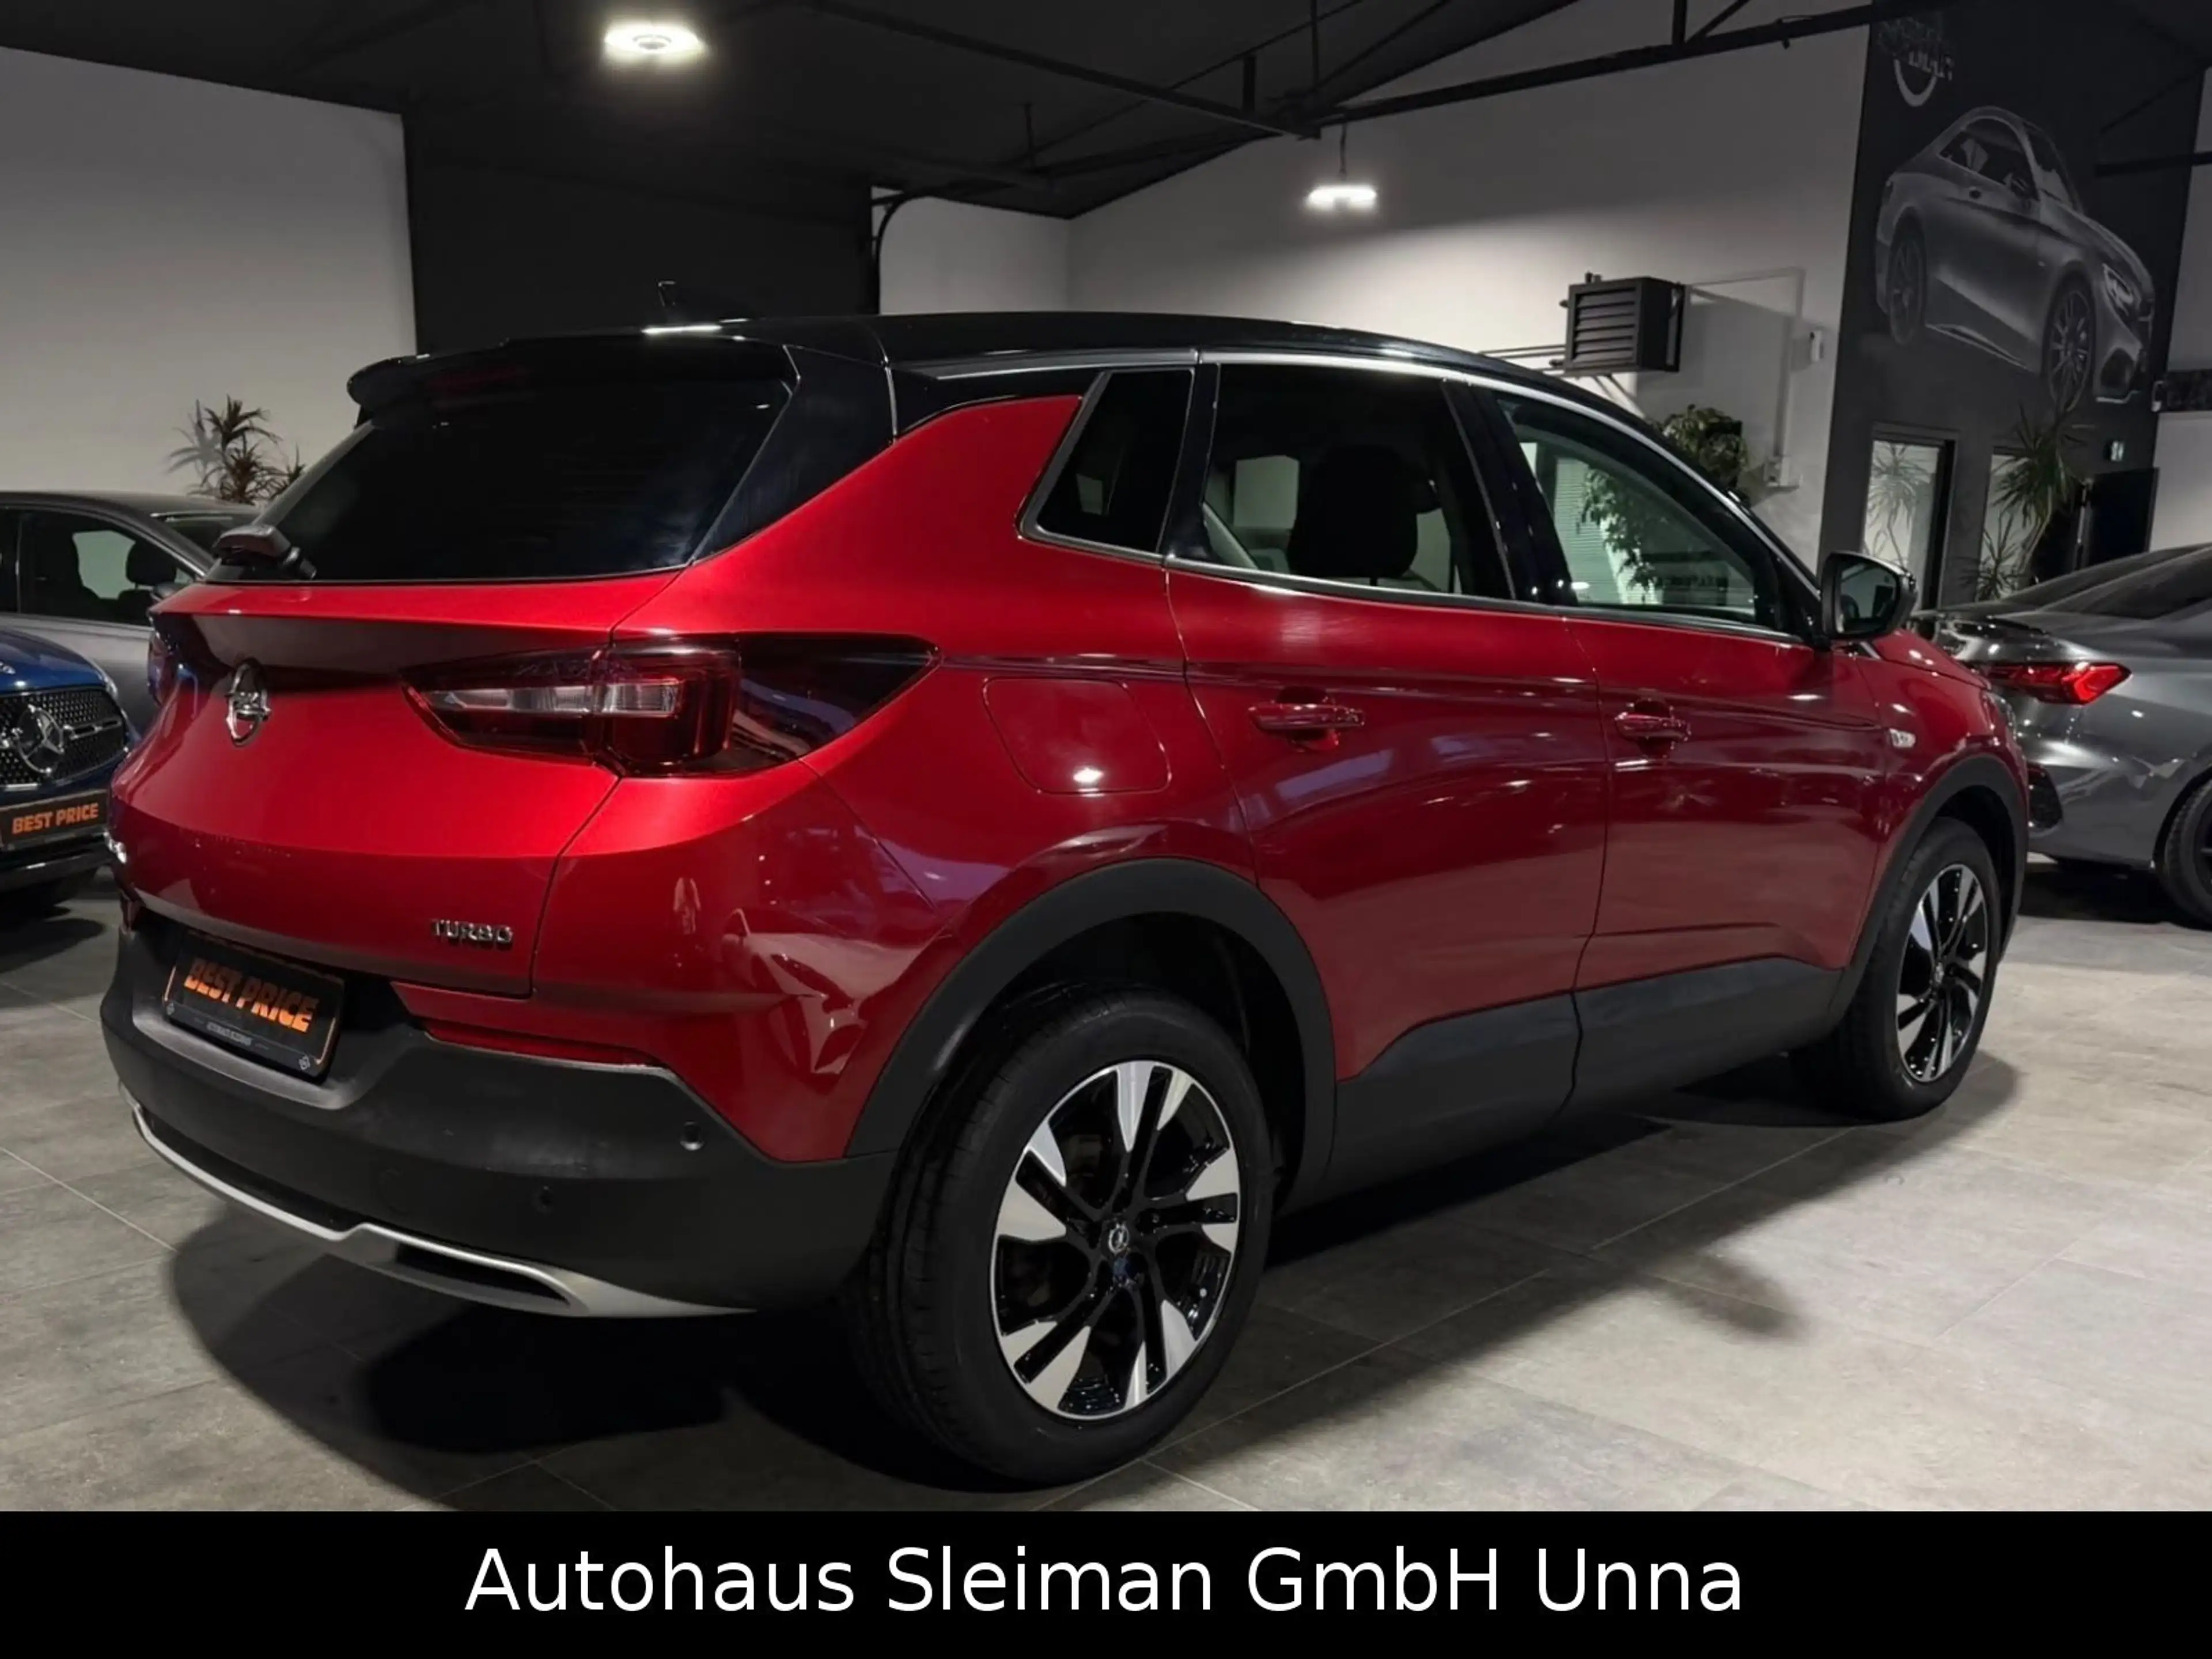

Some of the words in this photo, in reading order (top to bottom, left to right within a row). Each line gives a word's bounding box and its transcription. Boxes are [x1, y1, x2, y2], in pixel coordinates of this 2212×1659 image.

[12, 811, 53, 835] BEST
[56, 802, 99, 826] PRICE
[430, 918, 513, 943] TURBO
[183, 957, 243, 1003] BEST
[235, 976, 319, 1033] PRICE
